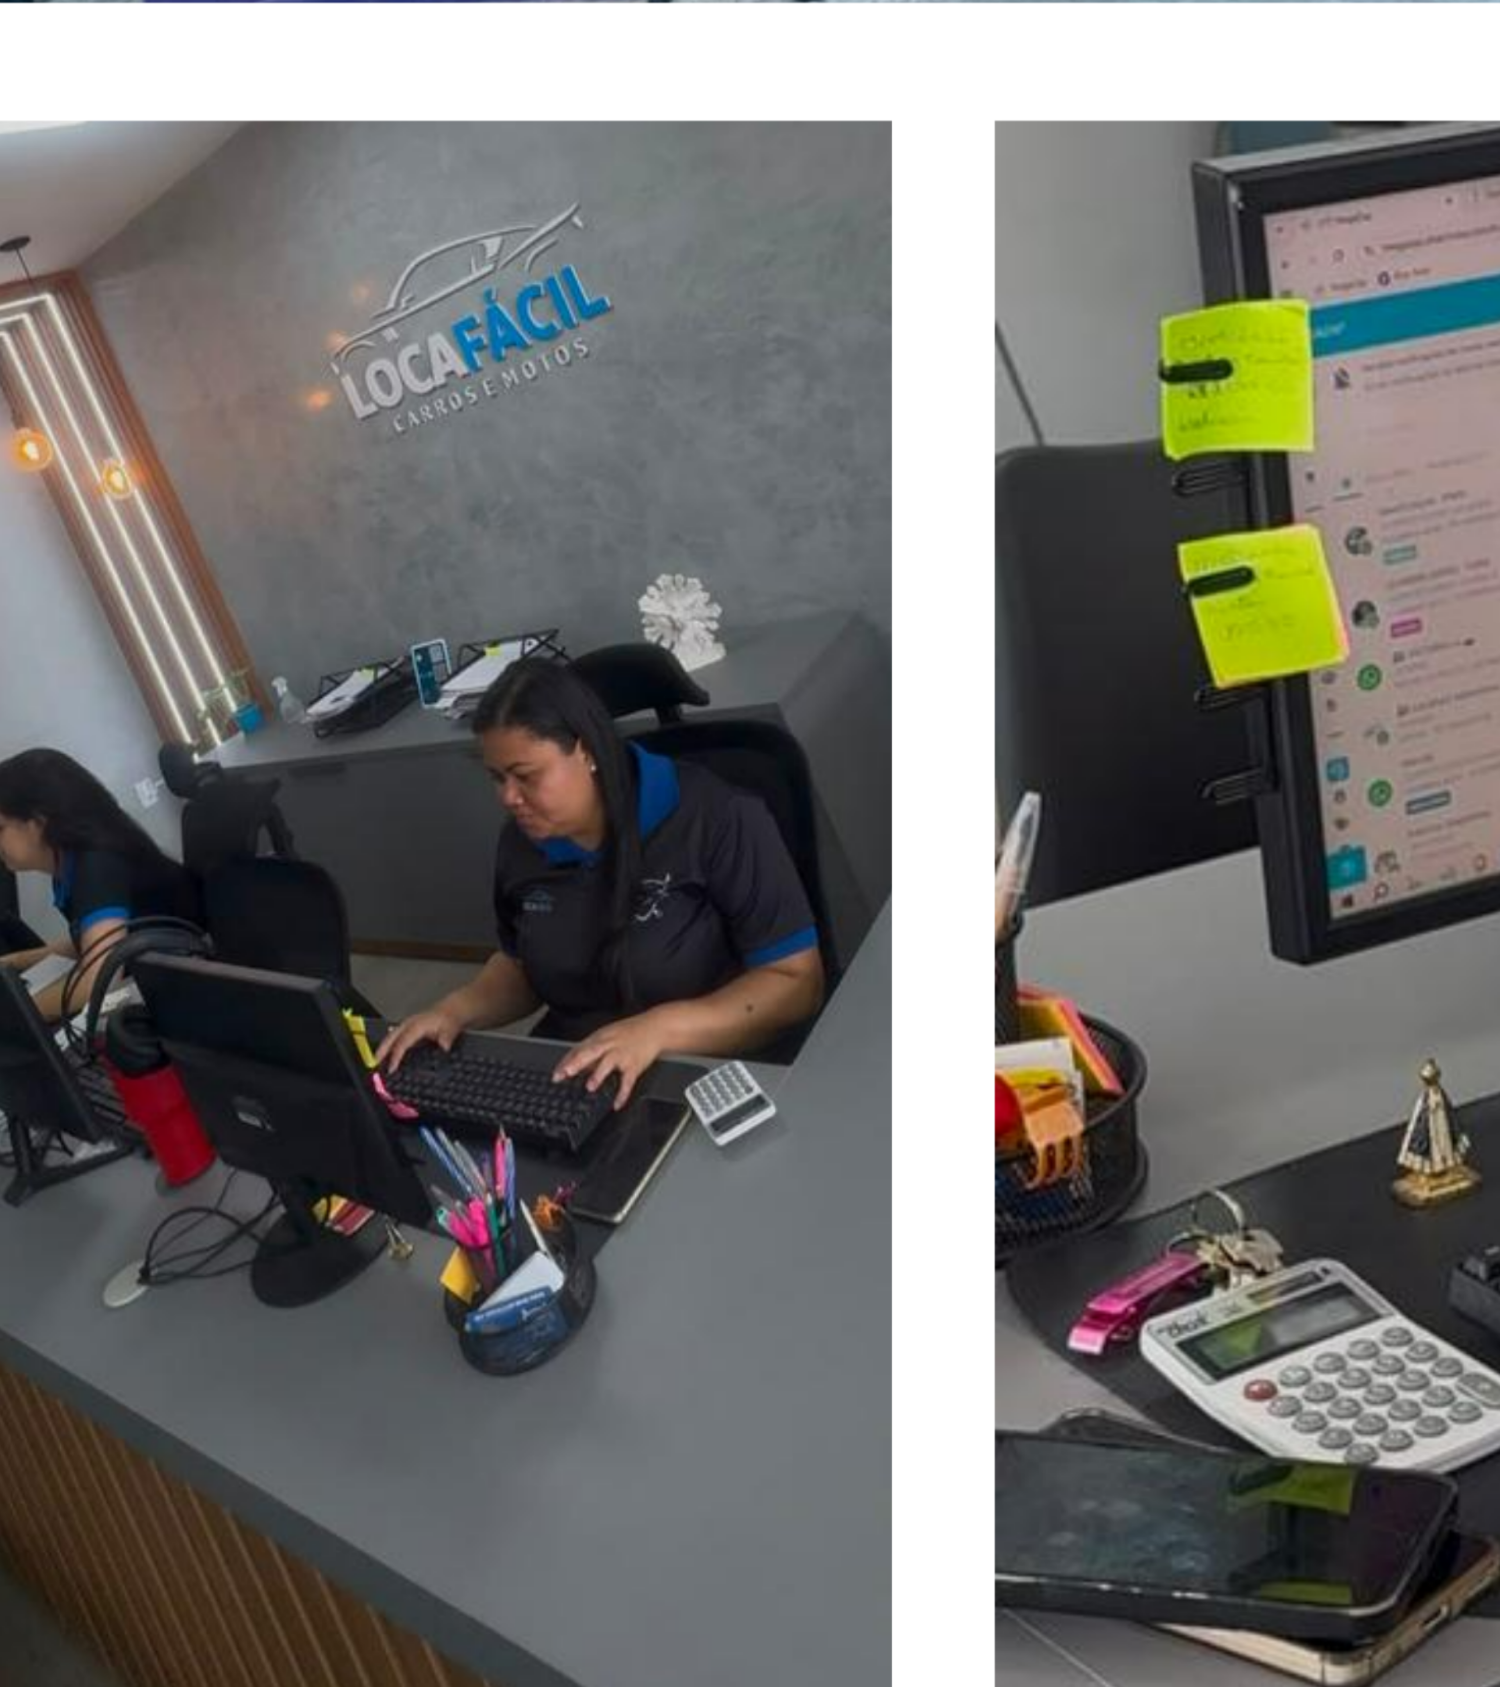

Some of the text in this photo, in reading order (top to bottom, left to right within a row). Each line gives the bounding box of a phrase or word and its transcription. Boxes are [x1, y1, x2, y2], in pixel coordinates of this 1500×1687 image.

[340, 264, 614, 420] LOCAFÁCIL
[392, 336, 590, 434] CARROS E MOTOS
